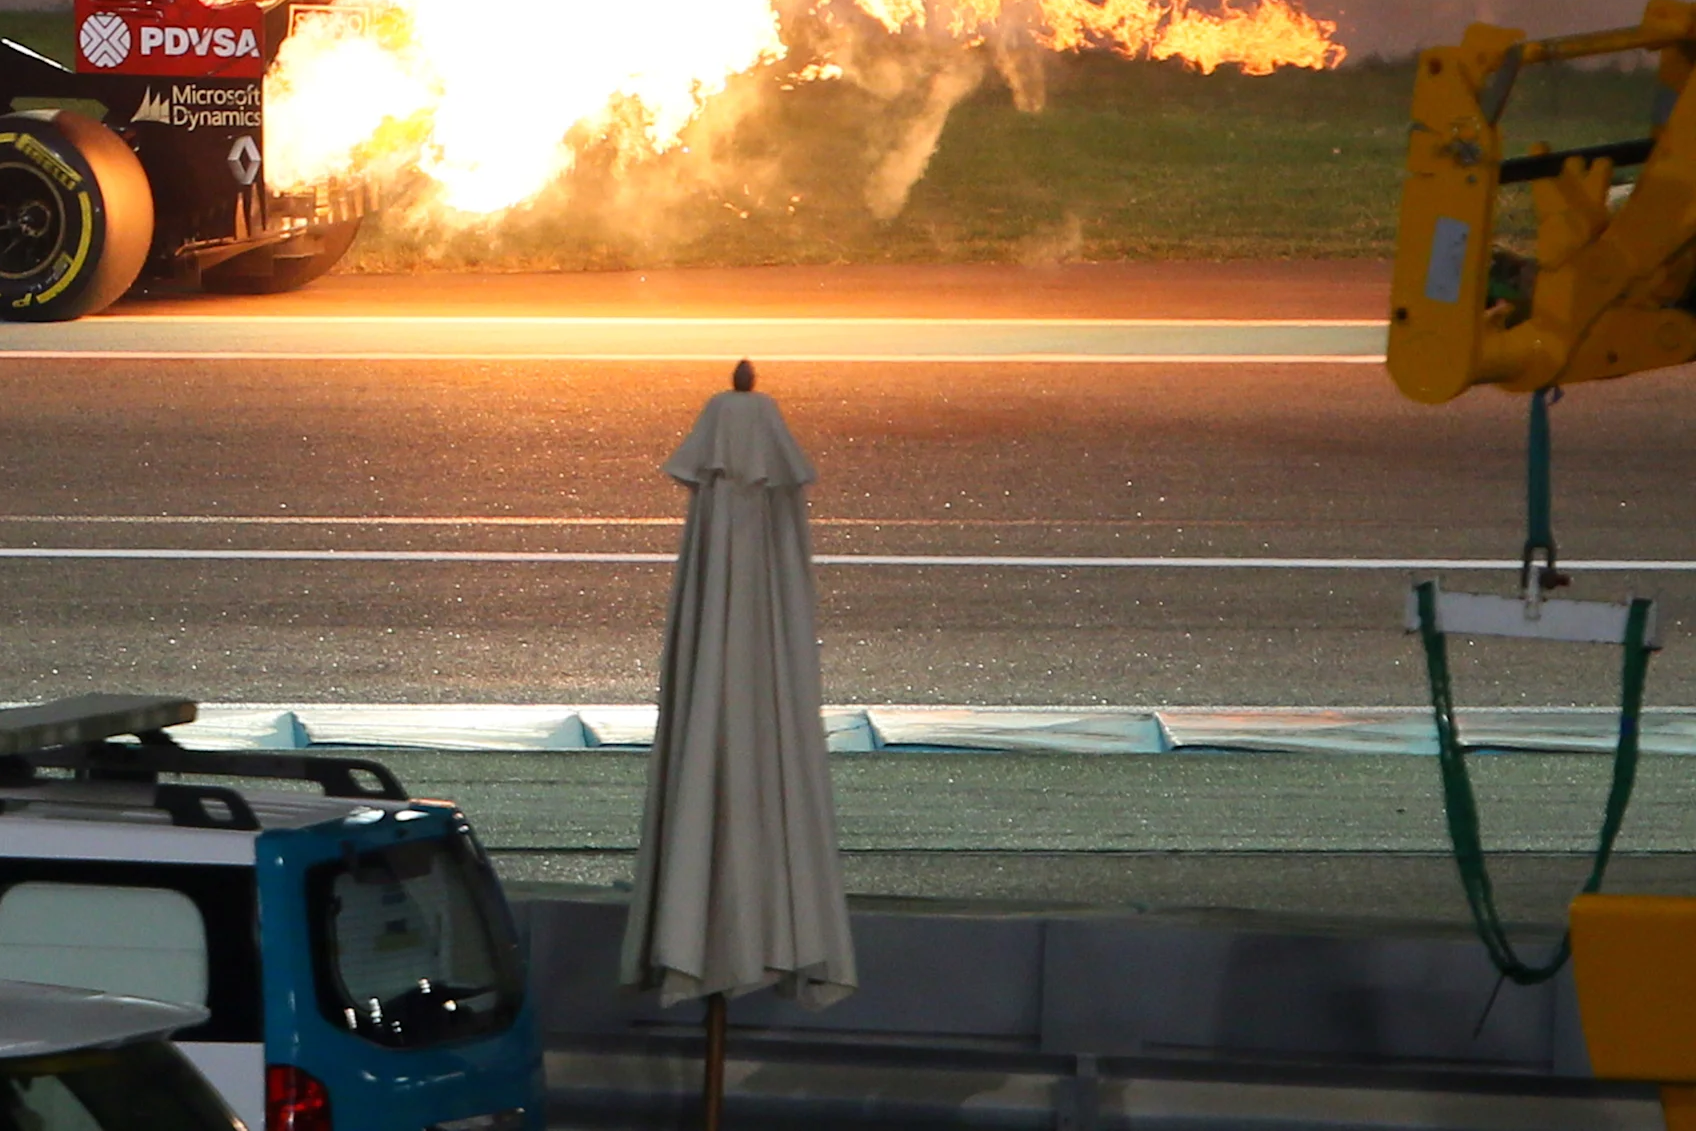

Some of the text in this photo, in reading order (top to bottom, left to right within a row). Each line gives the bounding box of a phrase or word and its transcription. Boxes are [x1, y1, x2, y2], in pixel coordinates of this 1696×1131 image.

[140, 26, 261, 58] PDVSA
[172, 83, 261, 105] Microsoft
[172, 106, 261, 131] Dynamics
[11, 292, 32, 308] P
